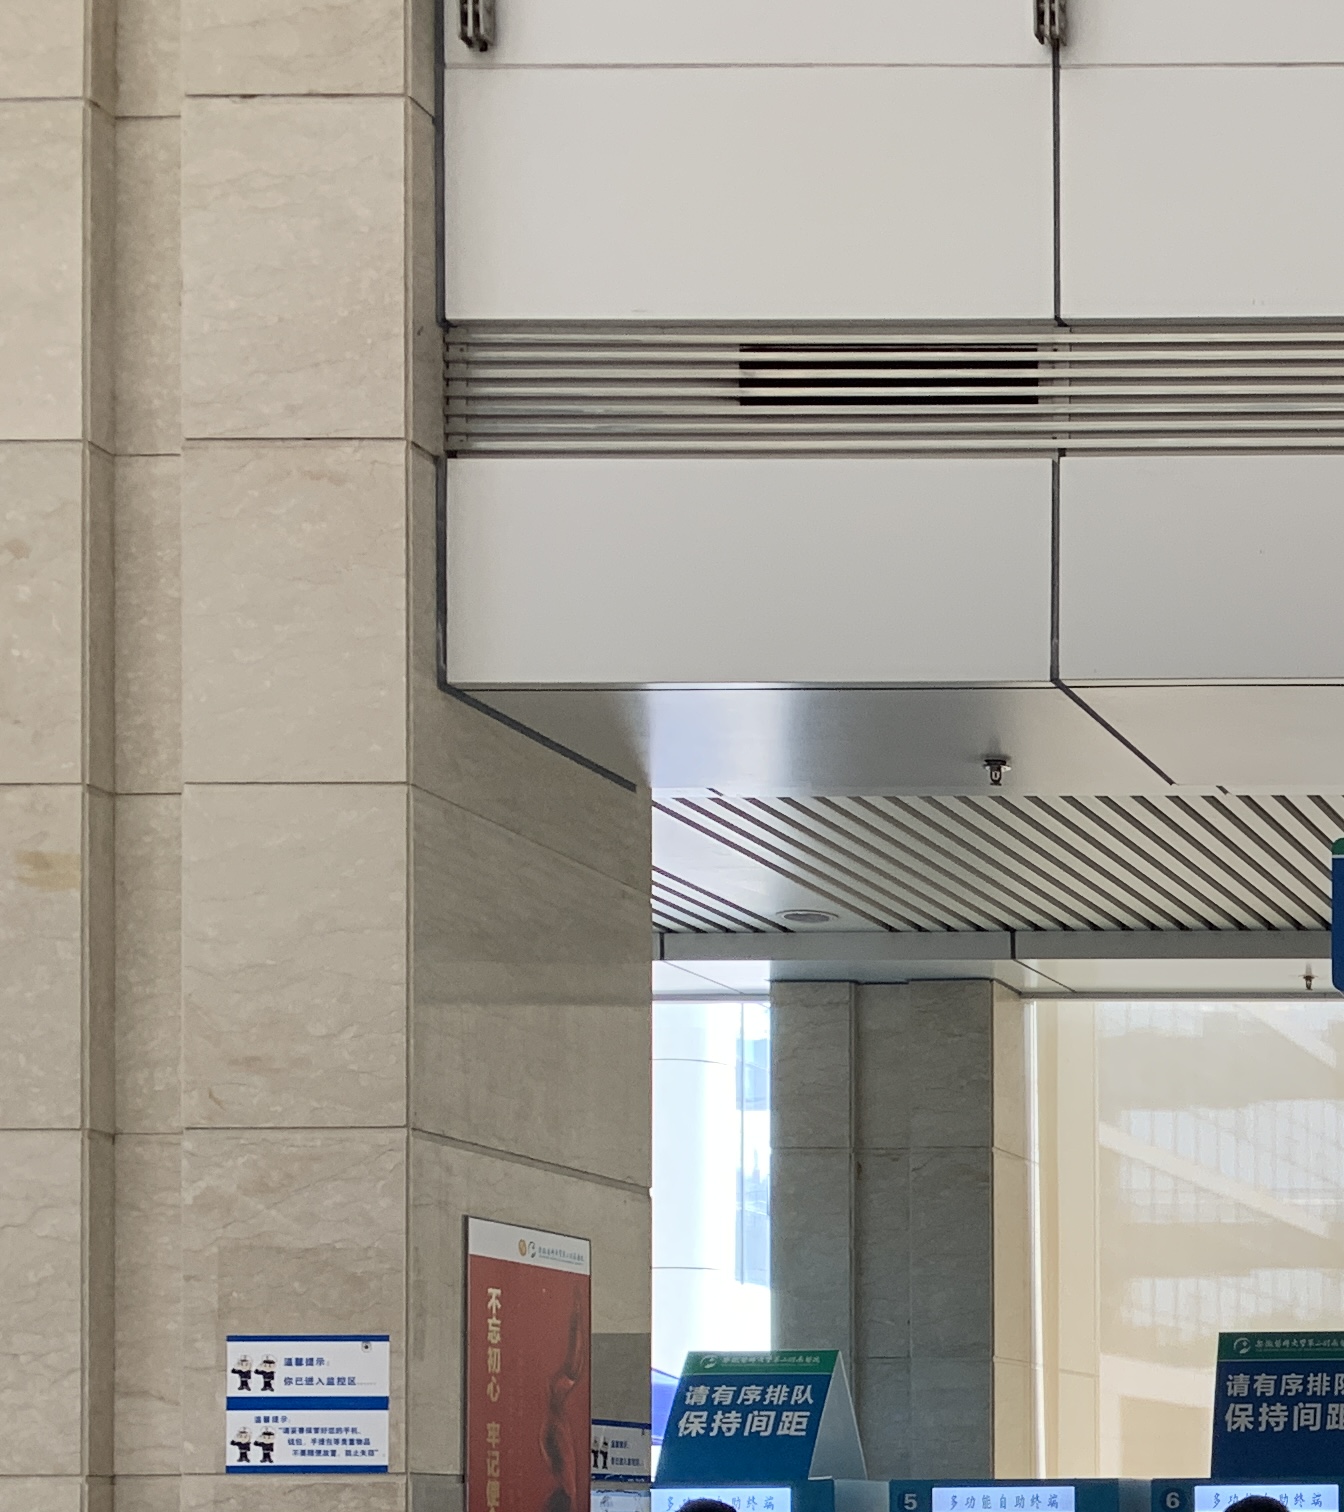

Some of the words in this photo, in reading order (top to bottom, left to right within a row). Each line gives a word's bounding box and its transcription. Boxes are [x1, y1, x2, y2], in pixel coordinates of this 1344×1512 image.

[487, 1287, 501, 1402] 不忘初心
[684, 1384, 815, 1406] 请有序排队
[678, 1410, 811, 1437] 保持间距
[904, 1493, 917, 1510] 5
[949, 1494, 1060, 1510] 多功能自助终端
[1165, 1491, 1180, 1509] 6
